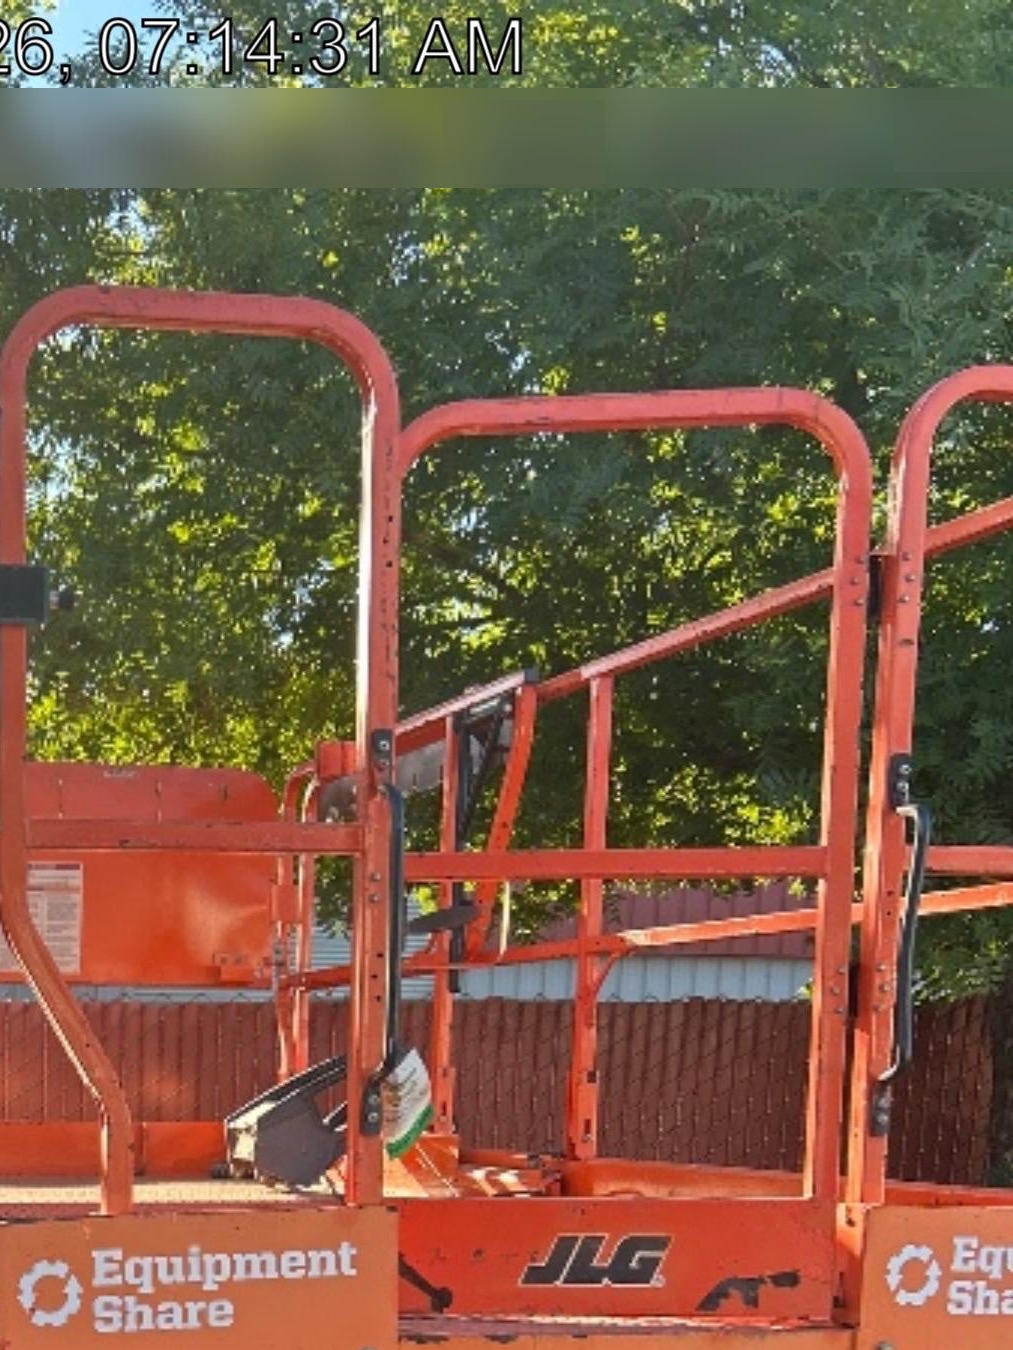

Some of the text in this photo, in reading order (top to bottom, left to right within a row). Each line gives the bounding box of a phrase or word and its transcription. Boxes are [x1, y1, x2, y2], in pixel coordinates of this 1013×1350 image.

[91, 1241, 357, 1294] Equipment
[518, 1232, 675, 1288] JLG
[950, 1234, 1013, 1279] Eq
[93, 1295, 235, 1333] Share
